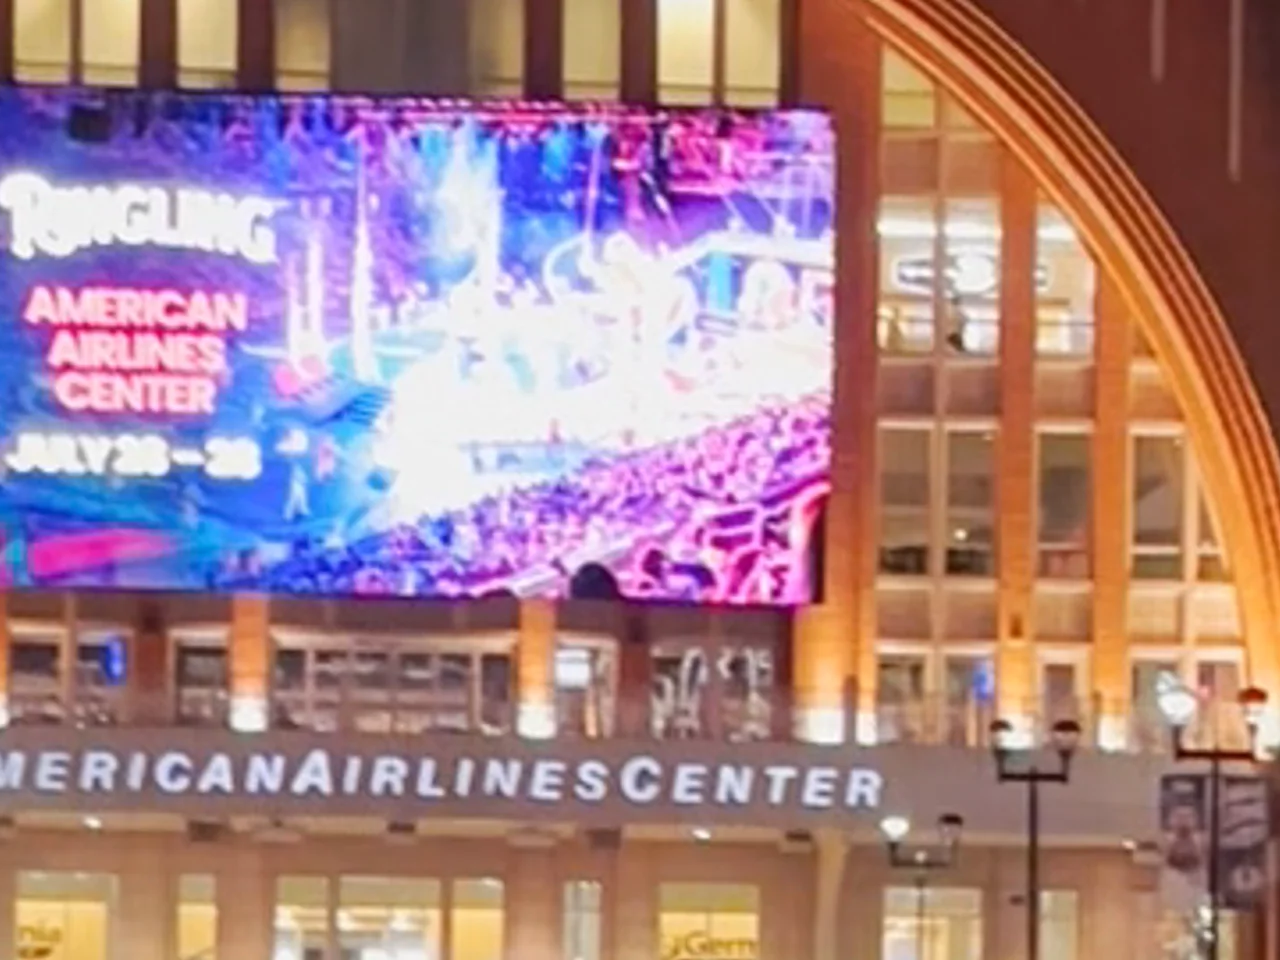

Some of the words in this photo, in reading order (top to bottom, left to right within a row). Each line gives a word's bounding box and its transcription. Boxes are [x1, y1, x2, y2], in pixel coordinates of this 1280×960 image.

[24, 285, 248, 331] AMERICAN
[47, 330, 228, 374] AIRLINES
[54, 373, 218, 414] CENTER
[4, 432, 111, 475] JULY
